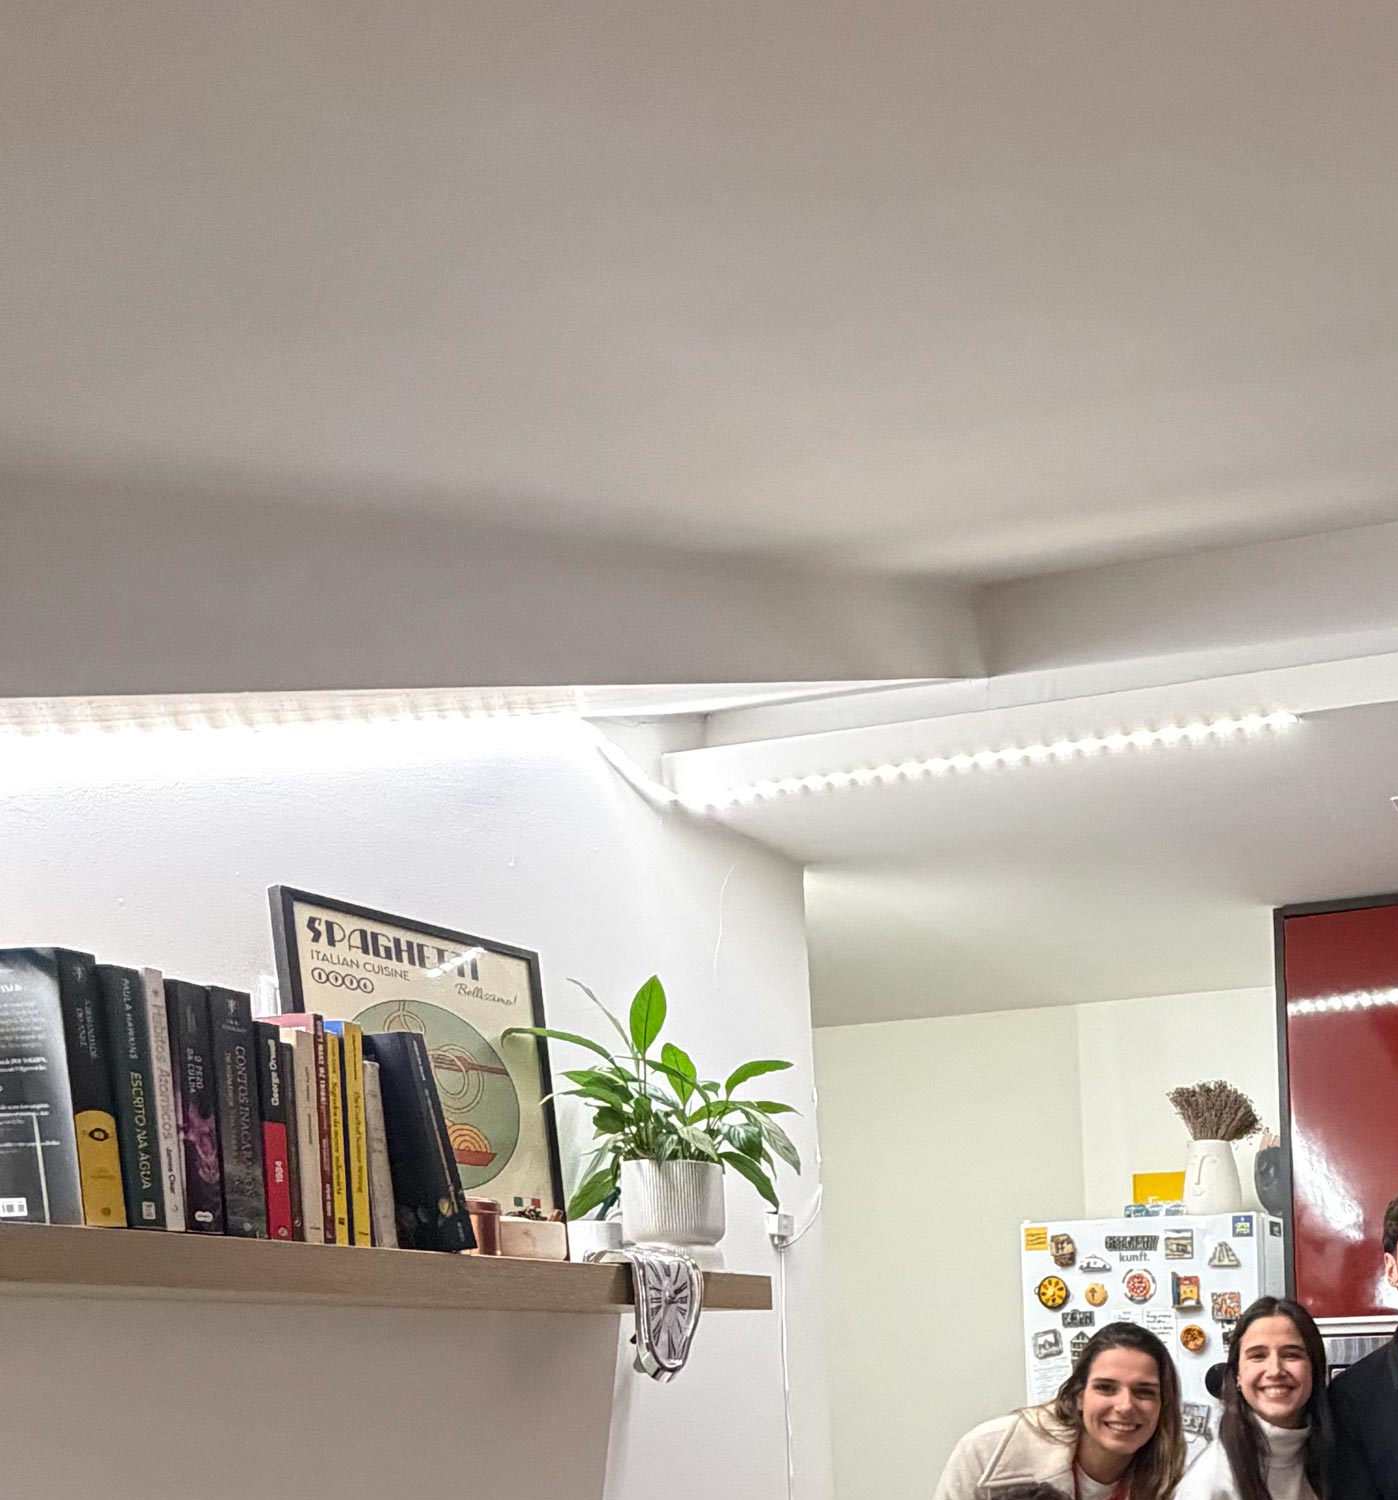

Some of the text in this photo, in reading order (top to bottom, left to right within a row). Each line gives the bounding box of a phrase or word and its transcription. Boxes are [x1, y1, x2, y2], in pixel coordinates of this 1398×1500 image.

[306, 915, 479, 982] SPAGHETTI
[310, 948, 411, 983] ITALIAN CUISINE
[121, 977, 137, 1060] PAULA HAWKINS
[130, 1071, 146, 1126] ESCRITO
[234, 1045, 249, 1105] CONTOS
[268, 1039, 281, 1106] George Orwell
[135, 1127, 148, 1148] NA
[275, 1160, 284, 1183] 1984
